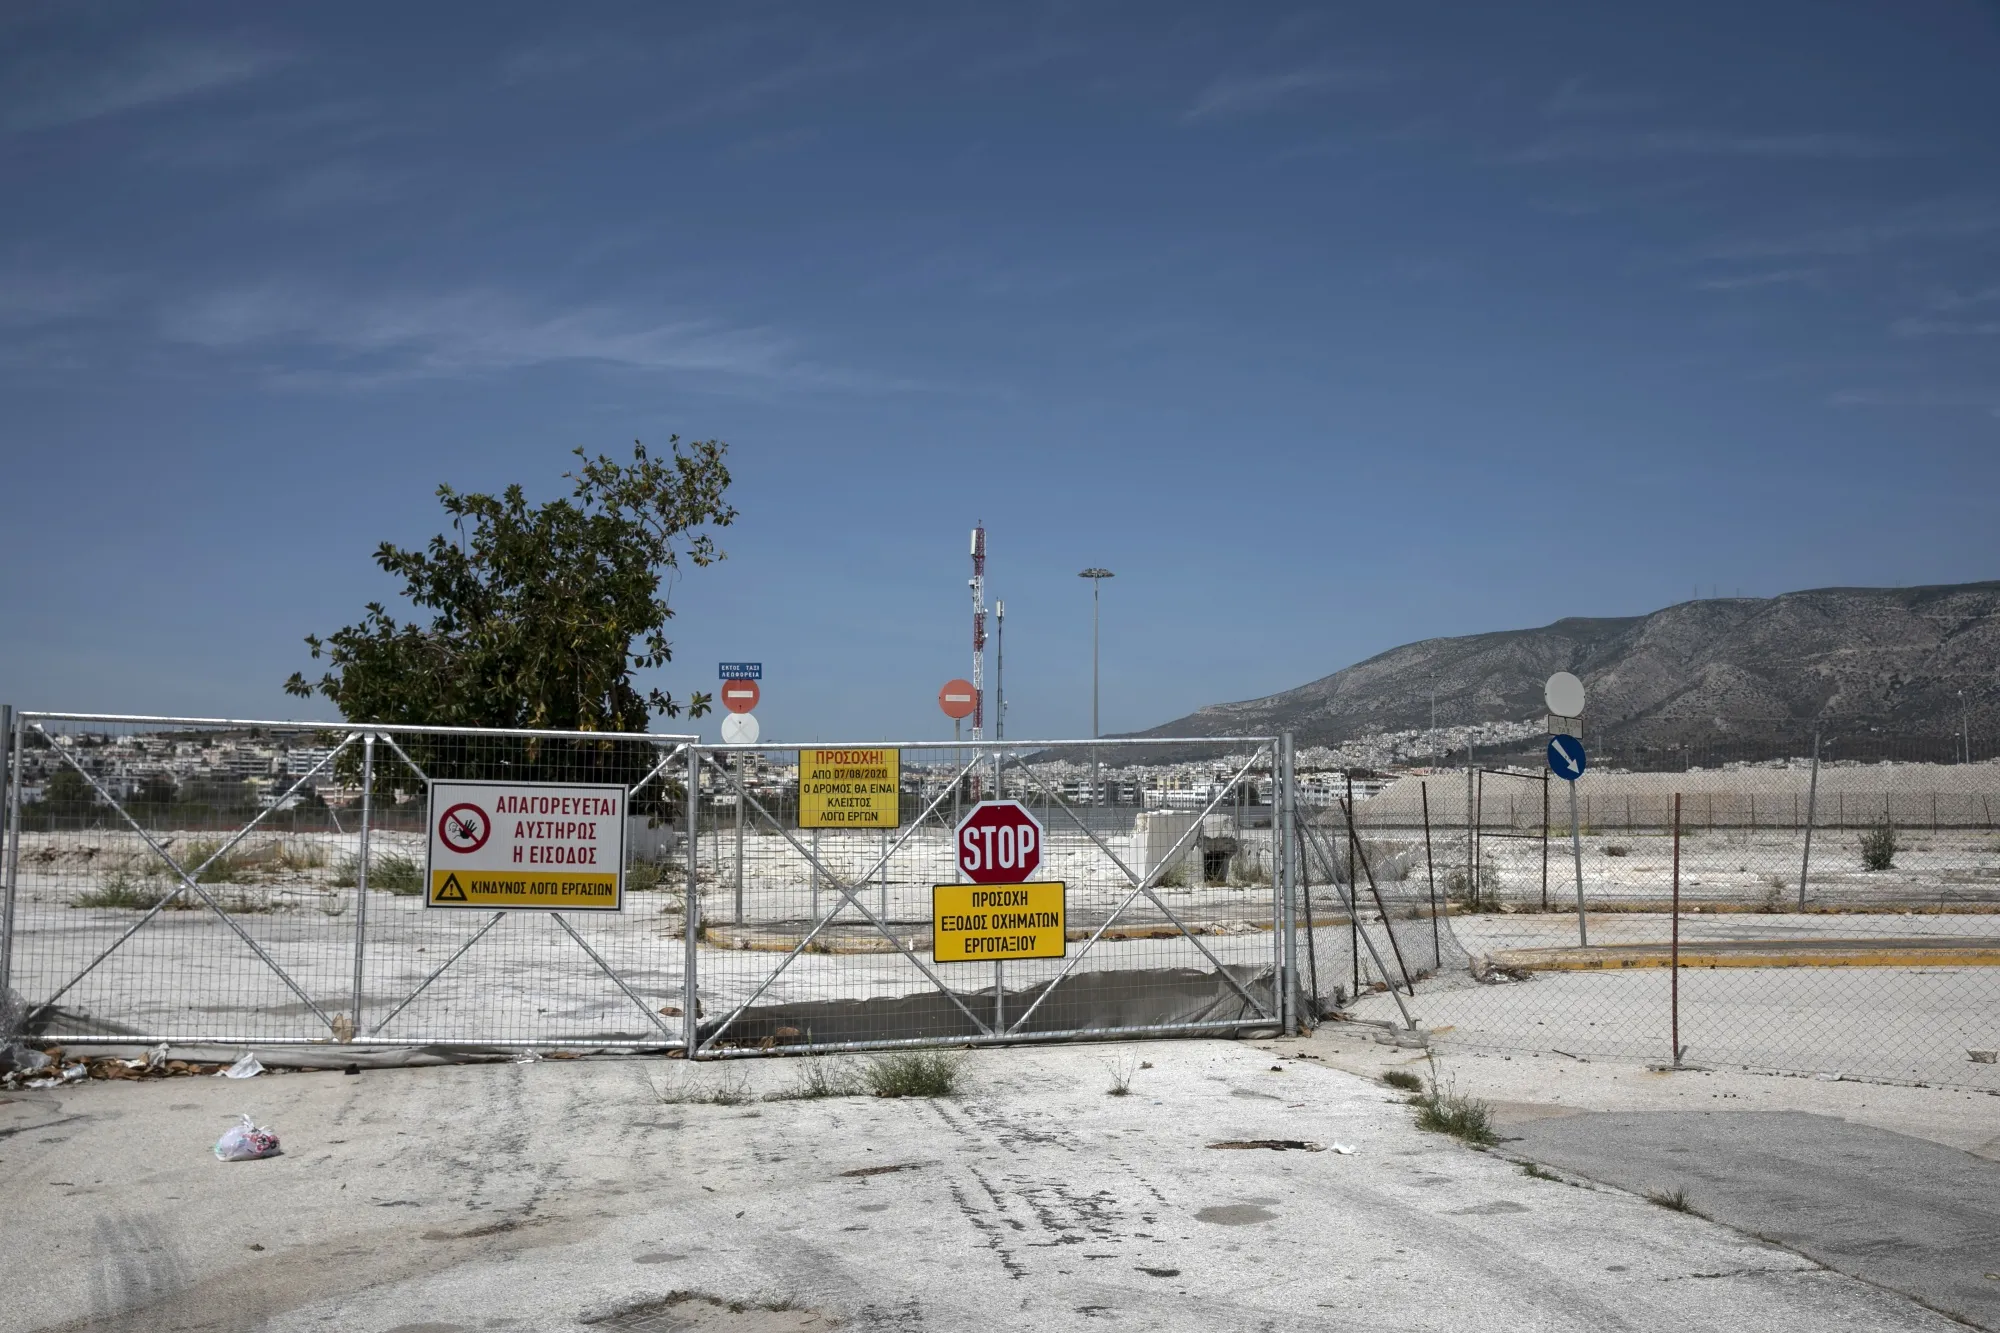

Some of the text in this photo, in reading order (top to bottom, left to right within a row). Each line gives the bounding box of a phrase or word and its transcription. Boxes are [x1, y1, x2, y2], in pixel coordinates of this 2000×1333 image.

[816, 751, 883, 764] ΠΡΟΣΟΧΗ!
[812, 770, 831, 779] ΑΠΟ
[813, 784, 851, 793] ΔΡΟΜΟΣ
[854, 784, 867, 793] ΘΑ
[871, 784, 895, 793] ΕΙΝΑΙ
[496, 796, 616, 816] ΑΠΑΓΟΡΕΥΕΤΑΙ
[827, 798, 871, 807] ΚΛΕΙΣΤΟΣ
[820, 812, 878, 821] ΛΟΓΩ ΕΡΓΩΝ
[515, 821, 597, 840] ΑΥΣΤΗΡΩΣ
[964, 824, 1035, 870] STOP
[513, 846, 597, 865] Η ΕΙΣΟΔΟΣ
[472, 881, 613, 896] ΚΙΝΔΥΝΟΣ ΛΟΓΩ ΕΡΓΑΣΙΩΝ
[972, 891, 1028, 907] ΠΡΟΣΟΧΗ
[941, 912, 1059, 931] ΕΞΟΔΟΣ ΟΧΗΜΑΤΩΝ
[965, 936, 1036, 953] ΕΡΓΟΤΑΞΙΟΥ
